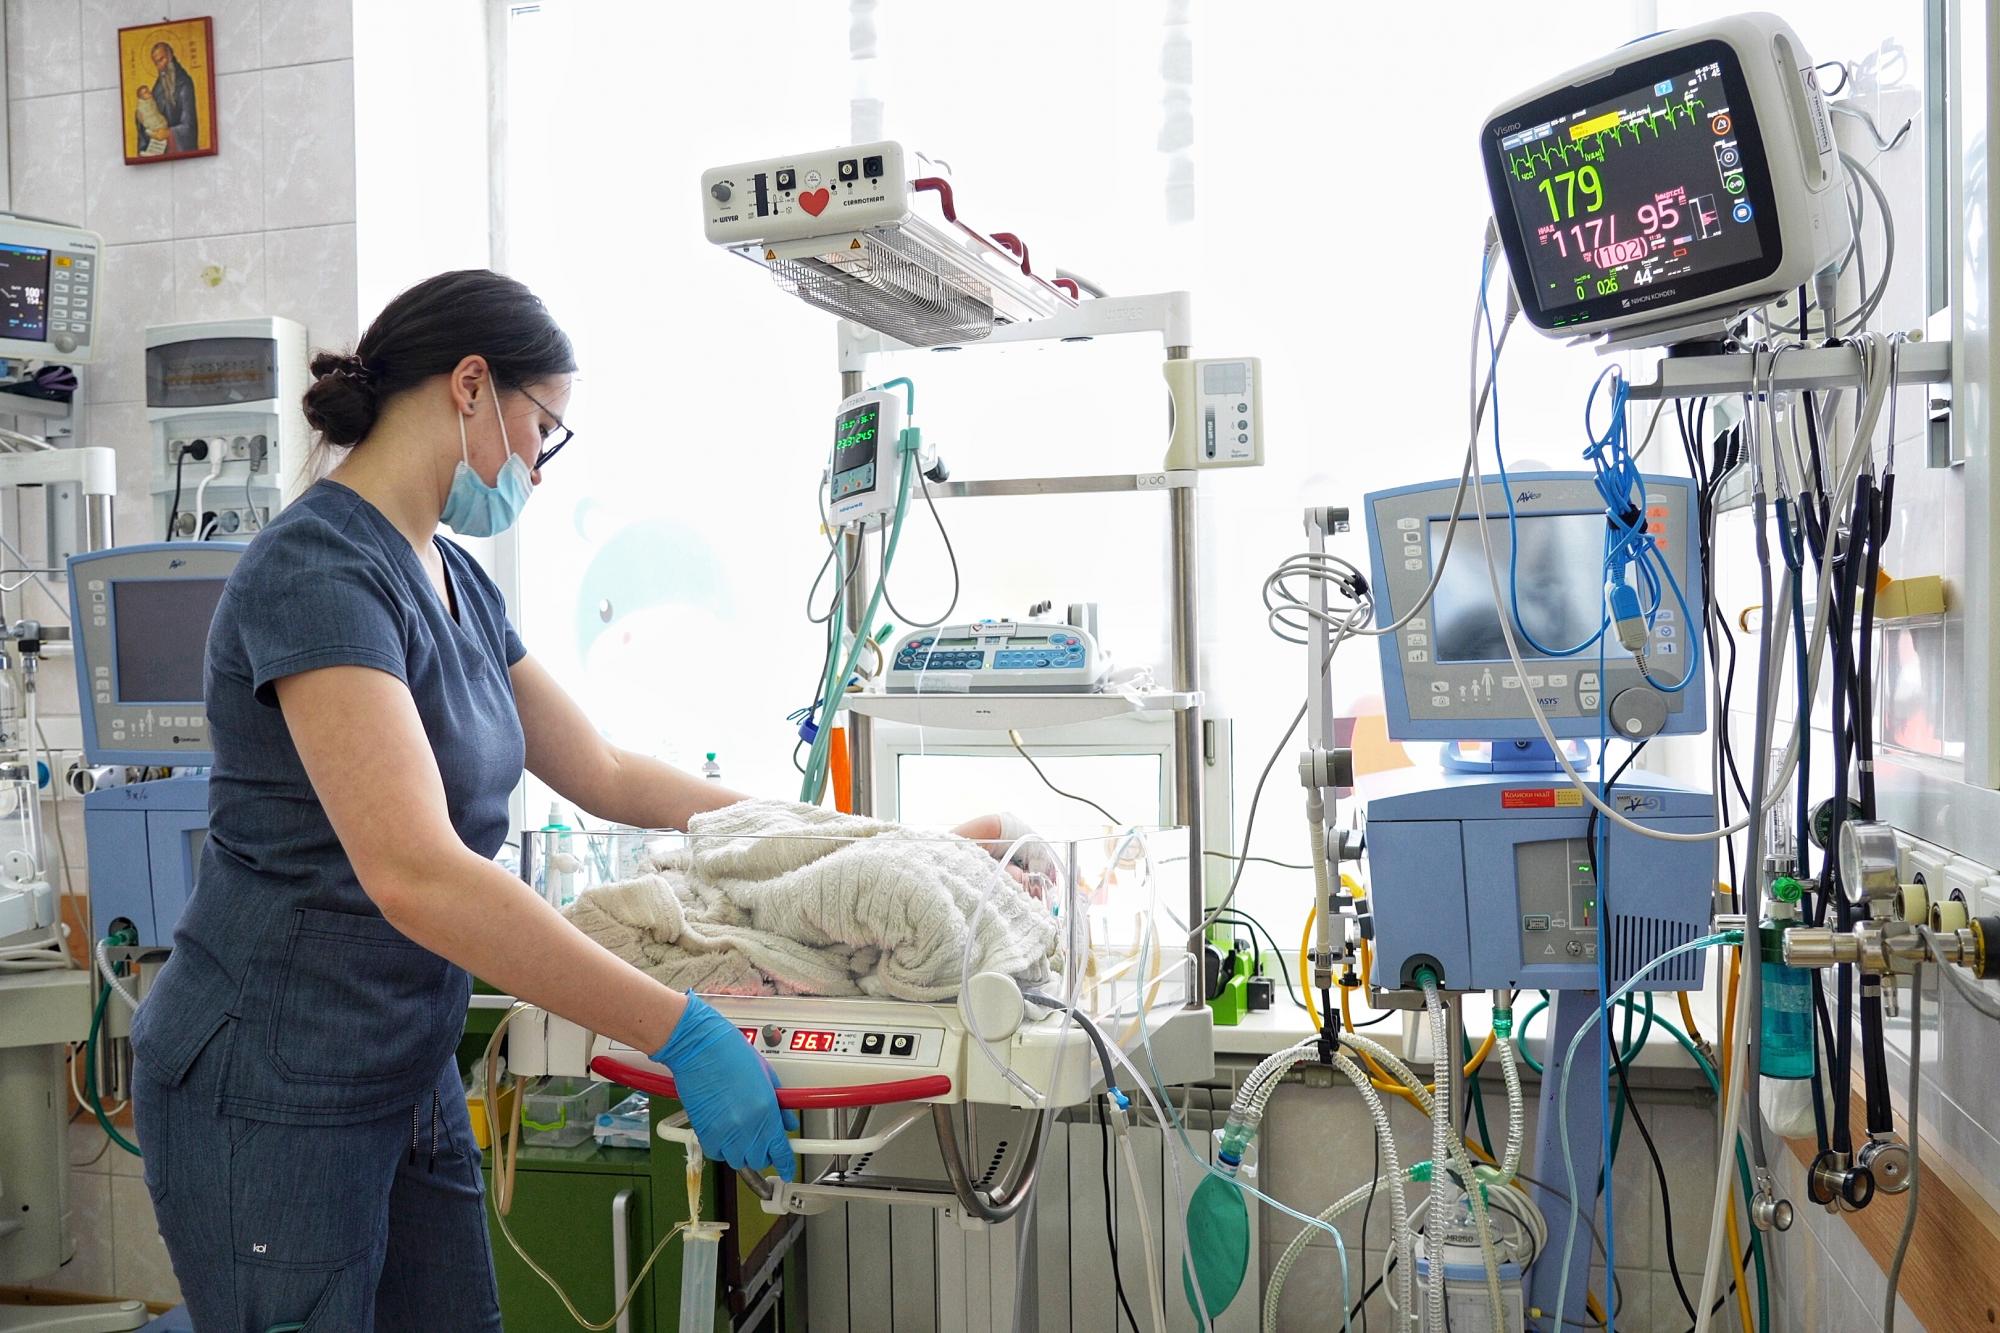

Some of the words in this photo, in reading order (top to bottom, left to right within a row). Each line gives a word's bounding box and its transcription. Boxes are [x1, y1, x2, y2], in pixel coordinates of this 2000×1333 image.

[1493, 122, 1521, 137] Vismo
[1538, 165, 1604, 223] 179
[1637, 197, 1679, 235] 95
[1633, 268, 1653, 285] 44
[1576, 286, 1585, 300] 0
[1631, 295, 1651, 304] NIHON
[1651, 289, 1676, 301] KOHDEN
[792, 1033, 832, 1050] 36.7
